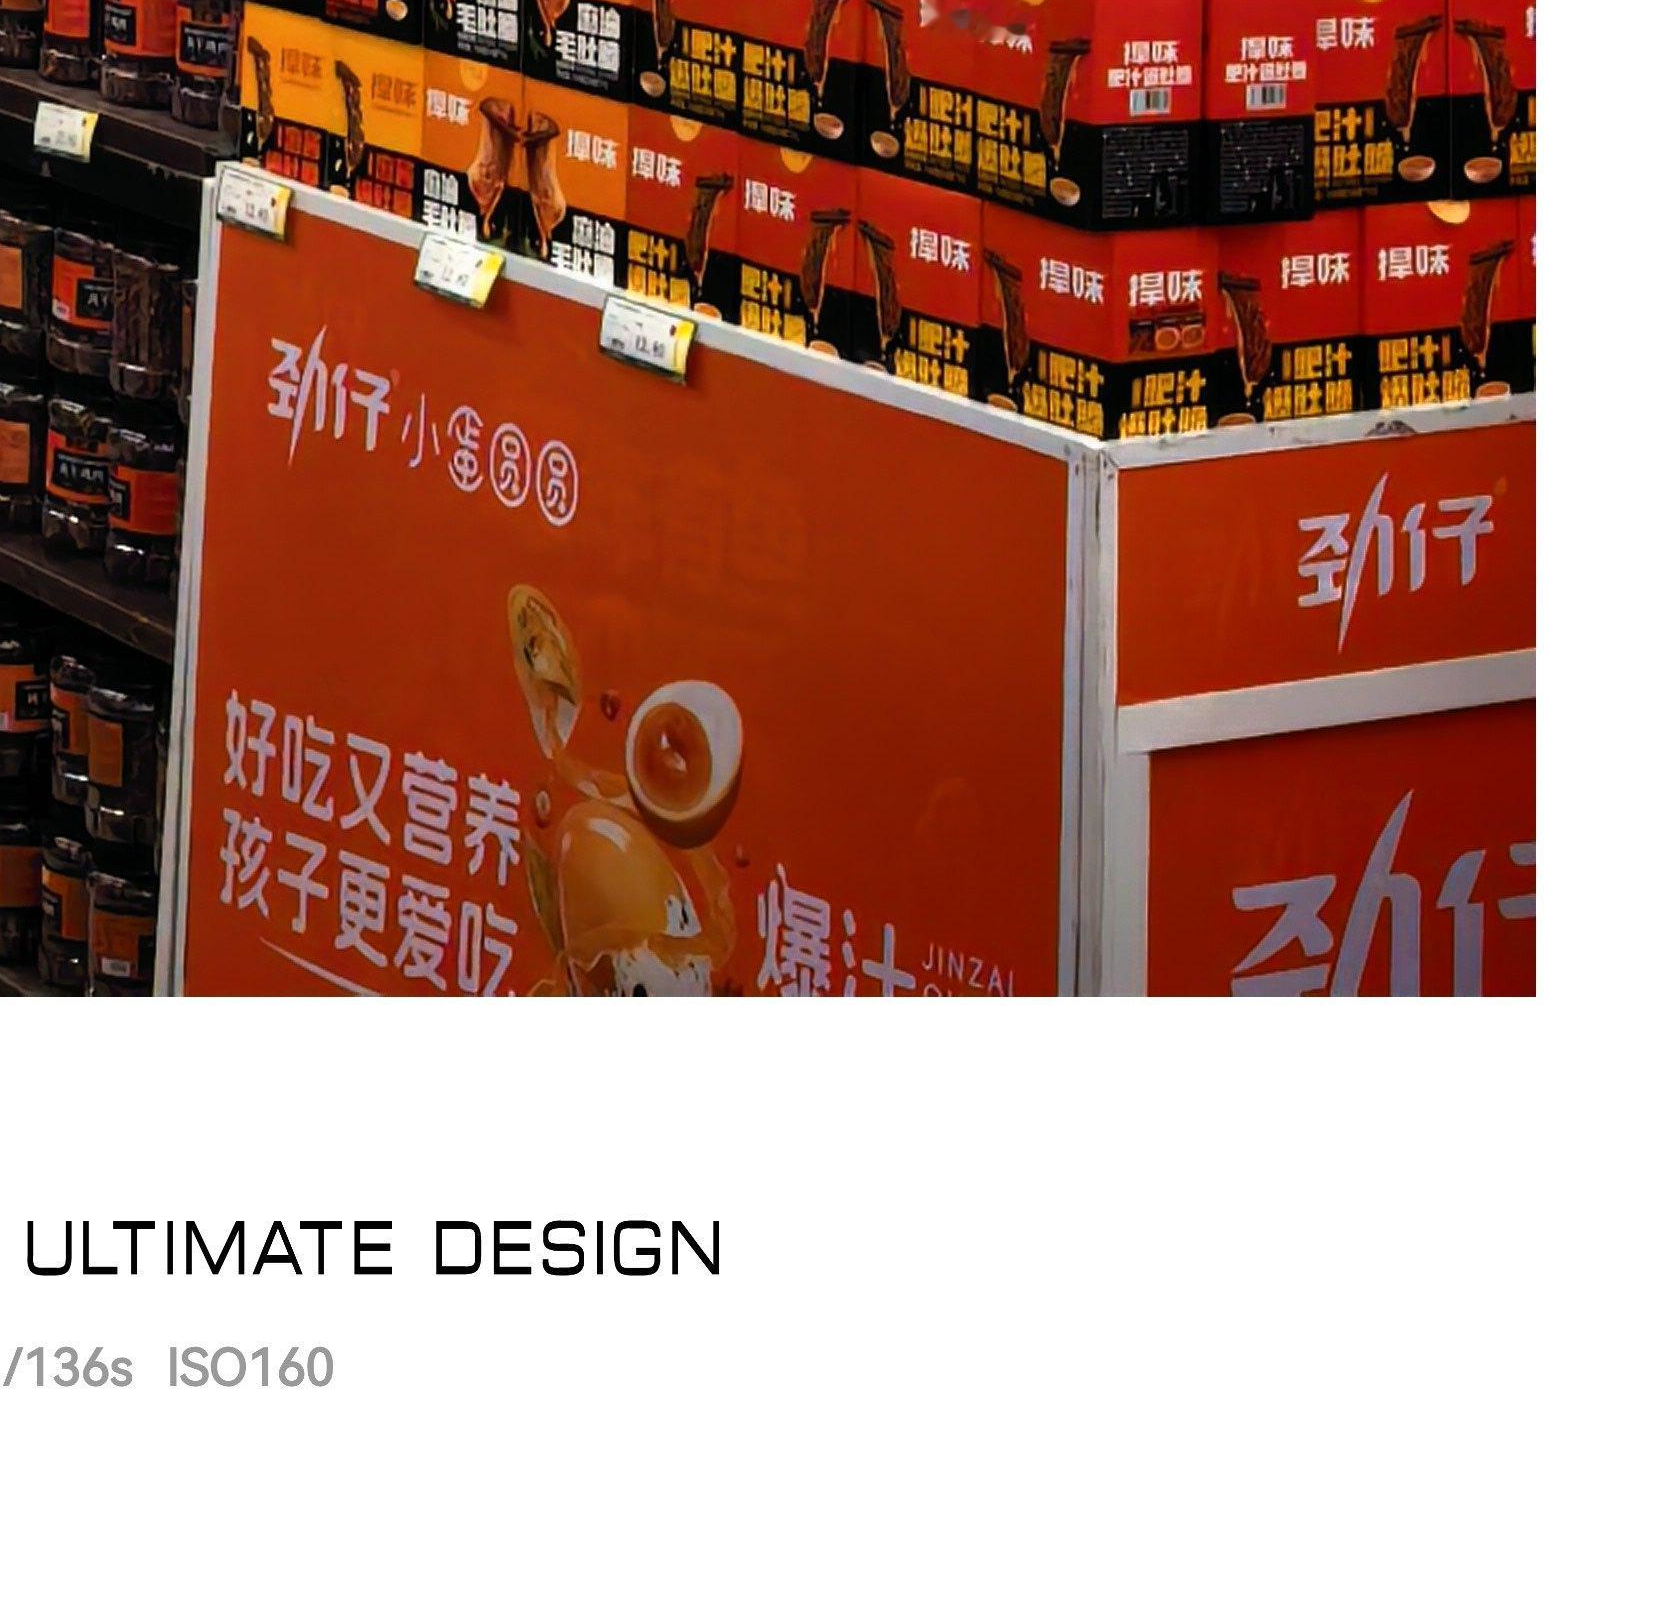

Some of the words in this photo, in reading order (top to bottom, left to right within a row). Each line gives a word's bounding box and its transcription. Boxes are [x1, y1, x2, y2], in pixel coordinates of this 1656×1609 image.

[267, 324, 392, 468] 劲仔
[401, 393, 579, 527] 小蛋圆圆
[1297, 471, 1495, 655] 劲仔
[223, 688, 522, 887] 好吃又营养
[219, 807, 519, 997] 孩子更爱吃
[757, 862, 916, 997] 爆汁
[922, 943, 1016, 996] JINZAI
